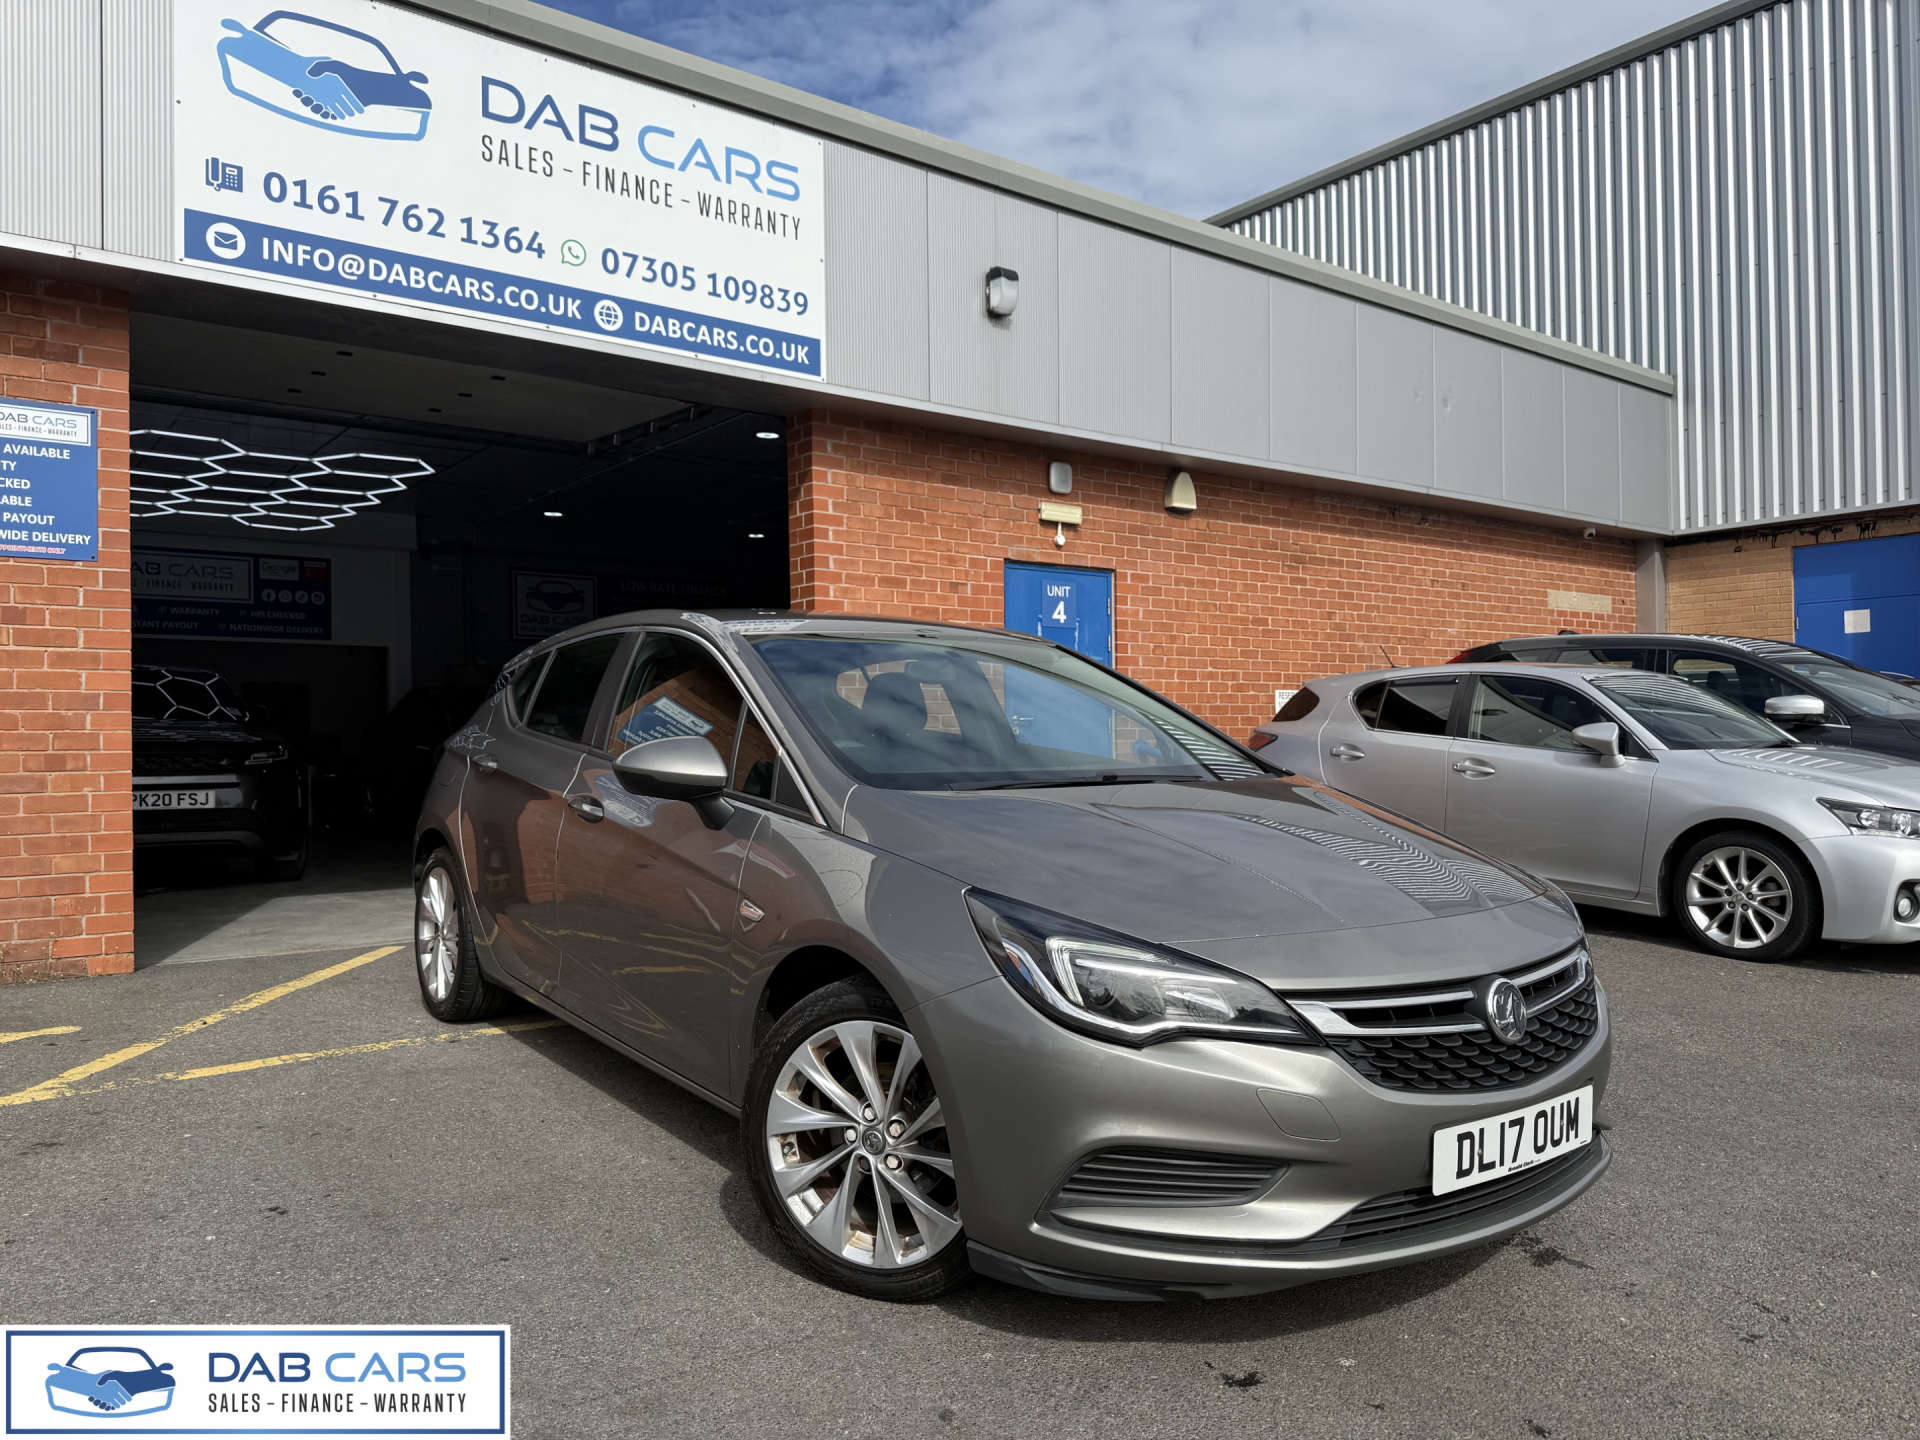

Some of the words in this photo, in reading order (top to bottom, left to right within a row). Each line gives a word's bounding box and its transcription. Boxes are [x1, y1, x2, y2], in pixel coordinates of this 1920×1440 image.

[481, 75, 620, 152] DAB
[637, 124, 801, 202] CARS
[480, 134, 554, 178] SALES
[582, 161, 674, 209] FINANCE
[697, 191, 801, 241] WARRANTY
[262, 171, 367, 222] 0161
[377, 195, 447, 239] 762
[459, 215, 547, 260] 1364
[261, 236, 583, 321] INFO@DABCARS.CO.UK
[600, 247, 697, 292] 07305
[706, 271, 809, 316] 109839
[633, 310, 810, 366] DABCARS.CO.UK
[18, 424, 42, 434] FINANCE
[48, 428, 77, 437] WARRANTY
[32, 415, 77, 429] CARS
[3, 443, 71, 460] AVAILABLE
[0, 494, 33, 507] ABLE
[3, 511, 56, 526] PAYOUT
[32, 531, 92, 545] DELIVERY
[132, 562, 161, 575] AB
[168, 564, 235, 580] CARS
[1047, 584, 1071, 598] UNIT
[1052, 600, 1067, 623] 4
[177, 792, 209, 806] FSJ
[1456, 1116, 1525, 1180] DL17
[1533, 1096, 1580, 1154] OUM
